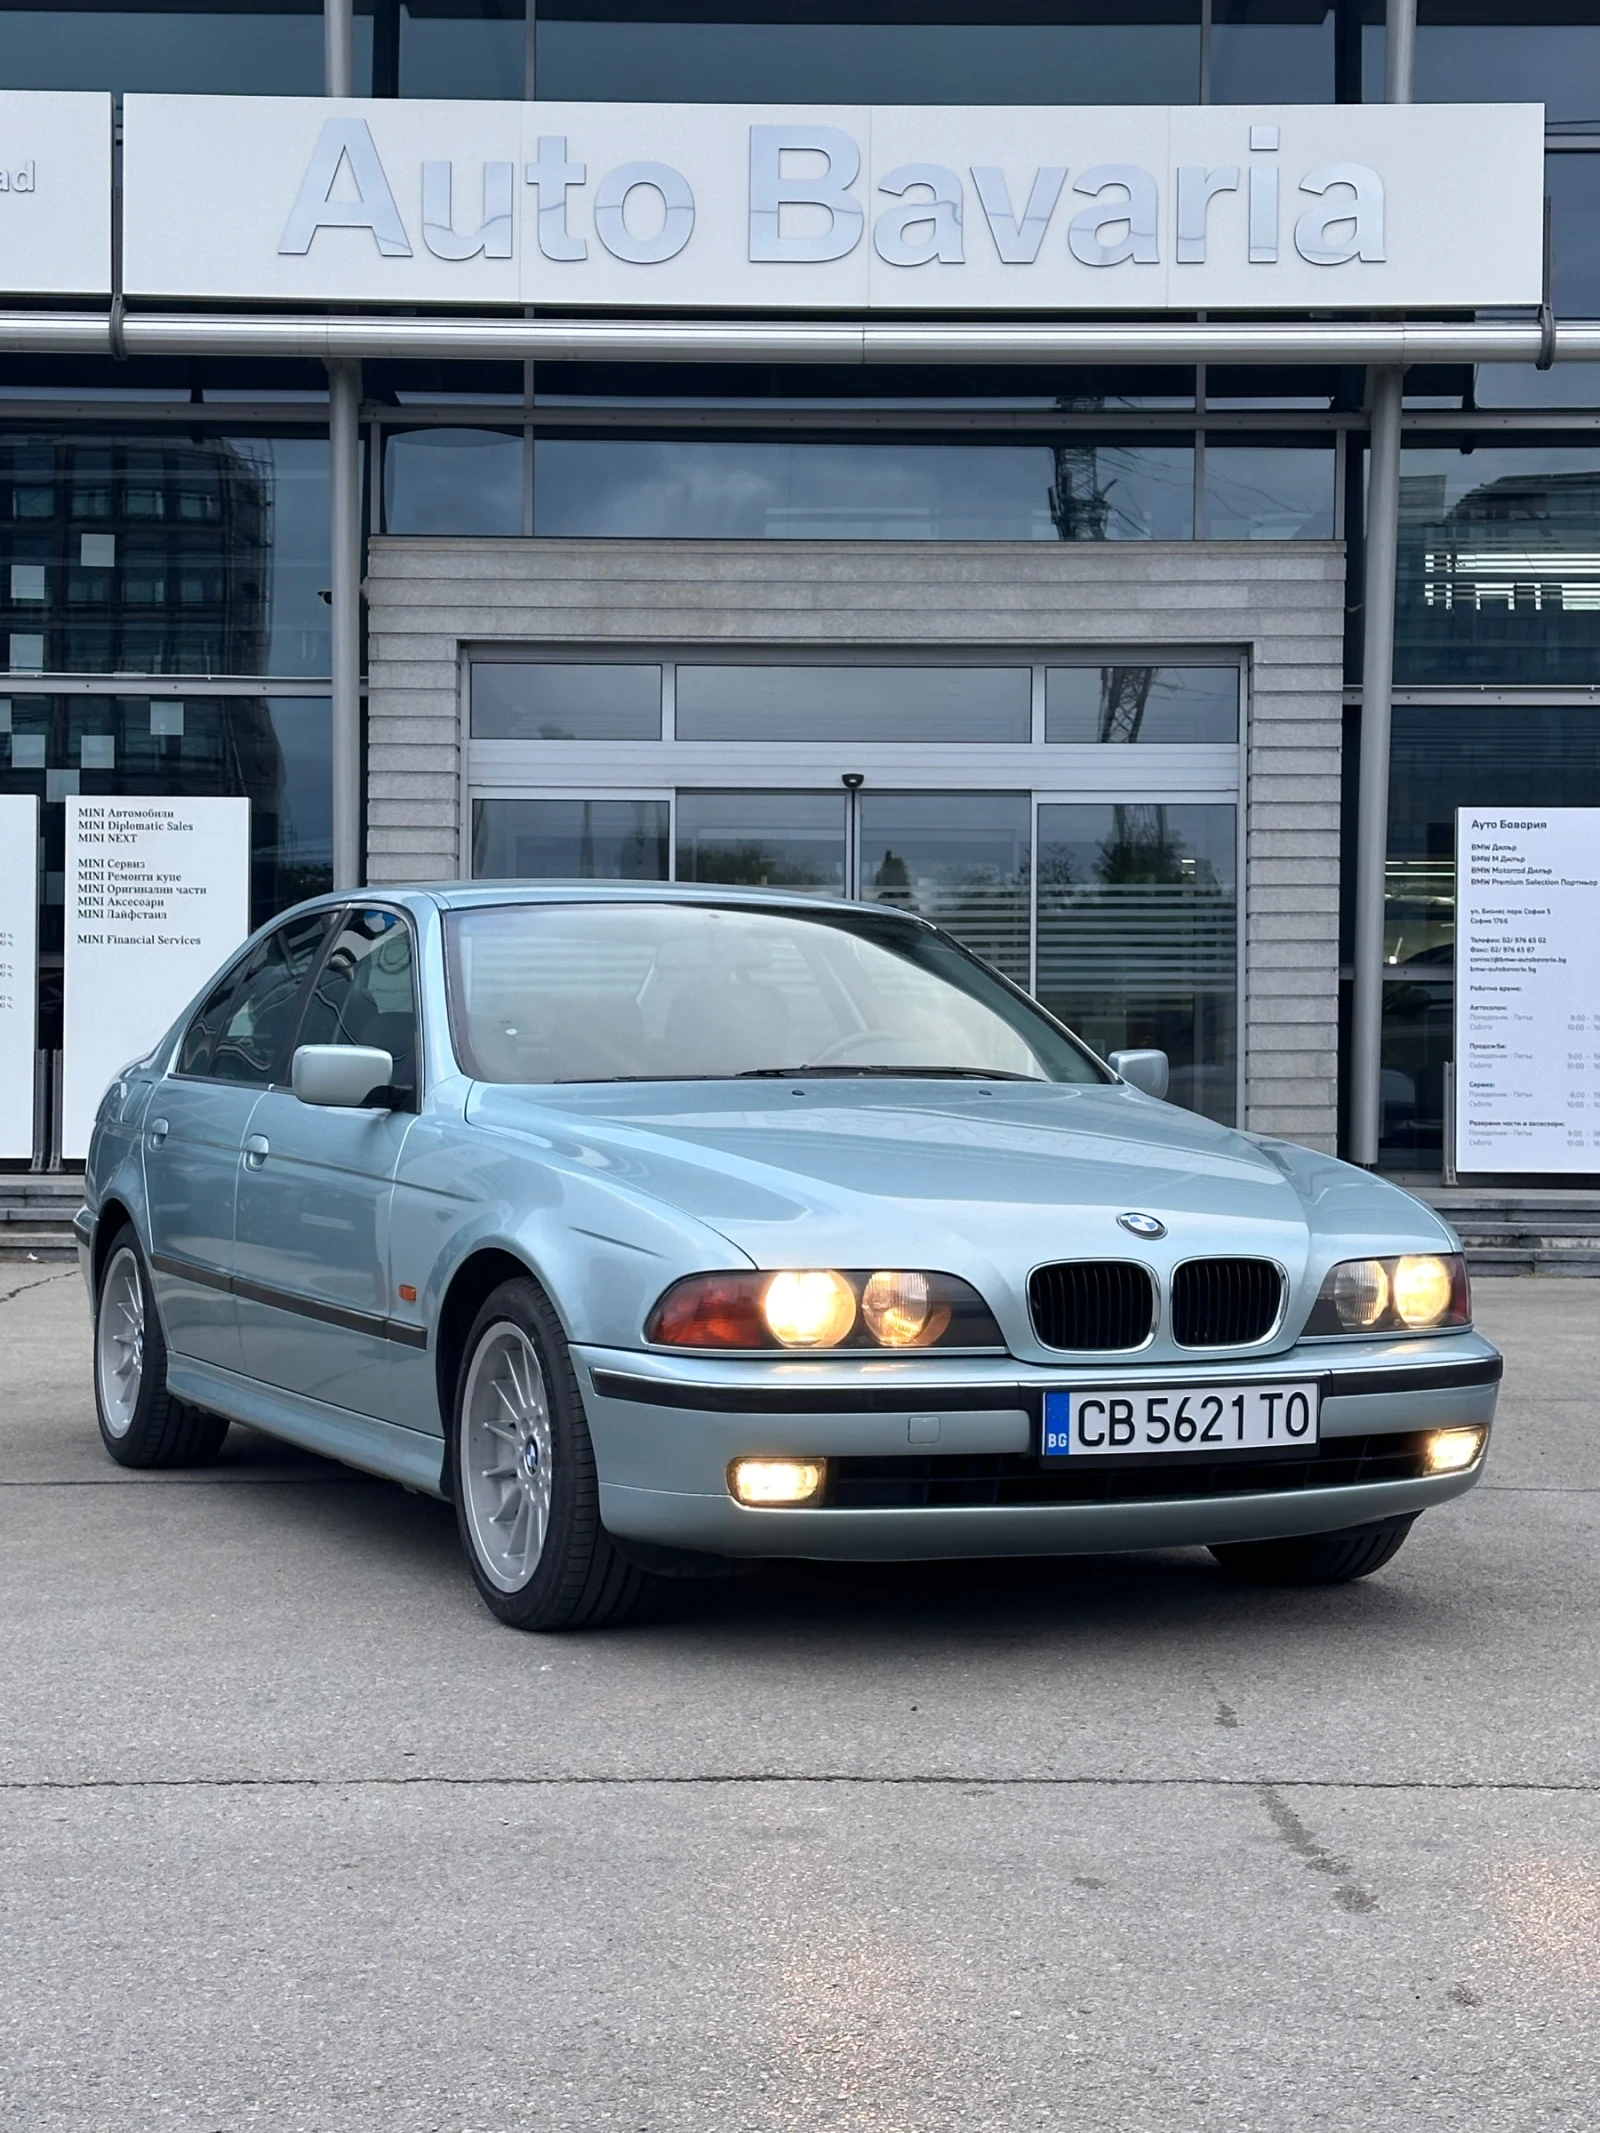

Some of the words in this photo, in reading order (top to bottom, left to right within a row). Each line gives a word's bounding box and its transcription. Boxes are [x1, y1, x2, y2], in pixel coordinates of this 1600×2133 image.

[278, 117, 695, 264] Auto
[748, 124, 1386, 267] Bavaria
[78, 808, 104, 818] MINI
[108, 808, 174, 818] Автомобили
[78, 821, 104, 830] MINI
[108, 821, 164, 832] Diplomatic
[167, 821, 193, 831] Sales
[1471, 820, 1497, 830] Ауто
[1500, 820, 1547, 830] Бавария
[78, 834, 104, 843] MINI
[108, 834, 138, 843] NEXT
[78, 859, 104, 868] MINI
[107, 859, 146, 870] Сервиз
[78, 872, 104, 881] MINI
[108, 872, 153, 881] Ремонти
[156, 874, 182, 884] купе
[78, 884, 104, 893] MINI
[107, 884, 173, 896] Оригинални
[78, 897, 104, 906] MINI
[107, 897, 164, 908] Аксесоари
[78, 909, 104, 919] MINI
[77, 934, 104, 944] MINI
[107, 935, 154, 944] Financial
[157, 935, 201, 945] Services
[1078, 1399, 1136, 1447] CB
[1146, 1394, 1244, 1444] 5621
[1260, 1391, 1310, 1439] TO
[1048, 1433, 1068, 1448] BG
